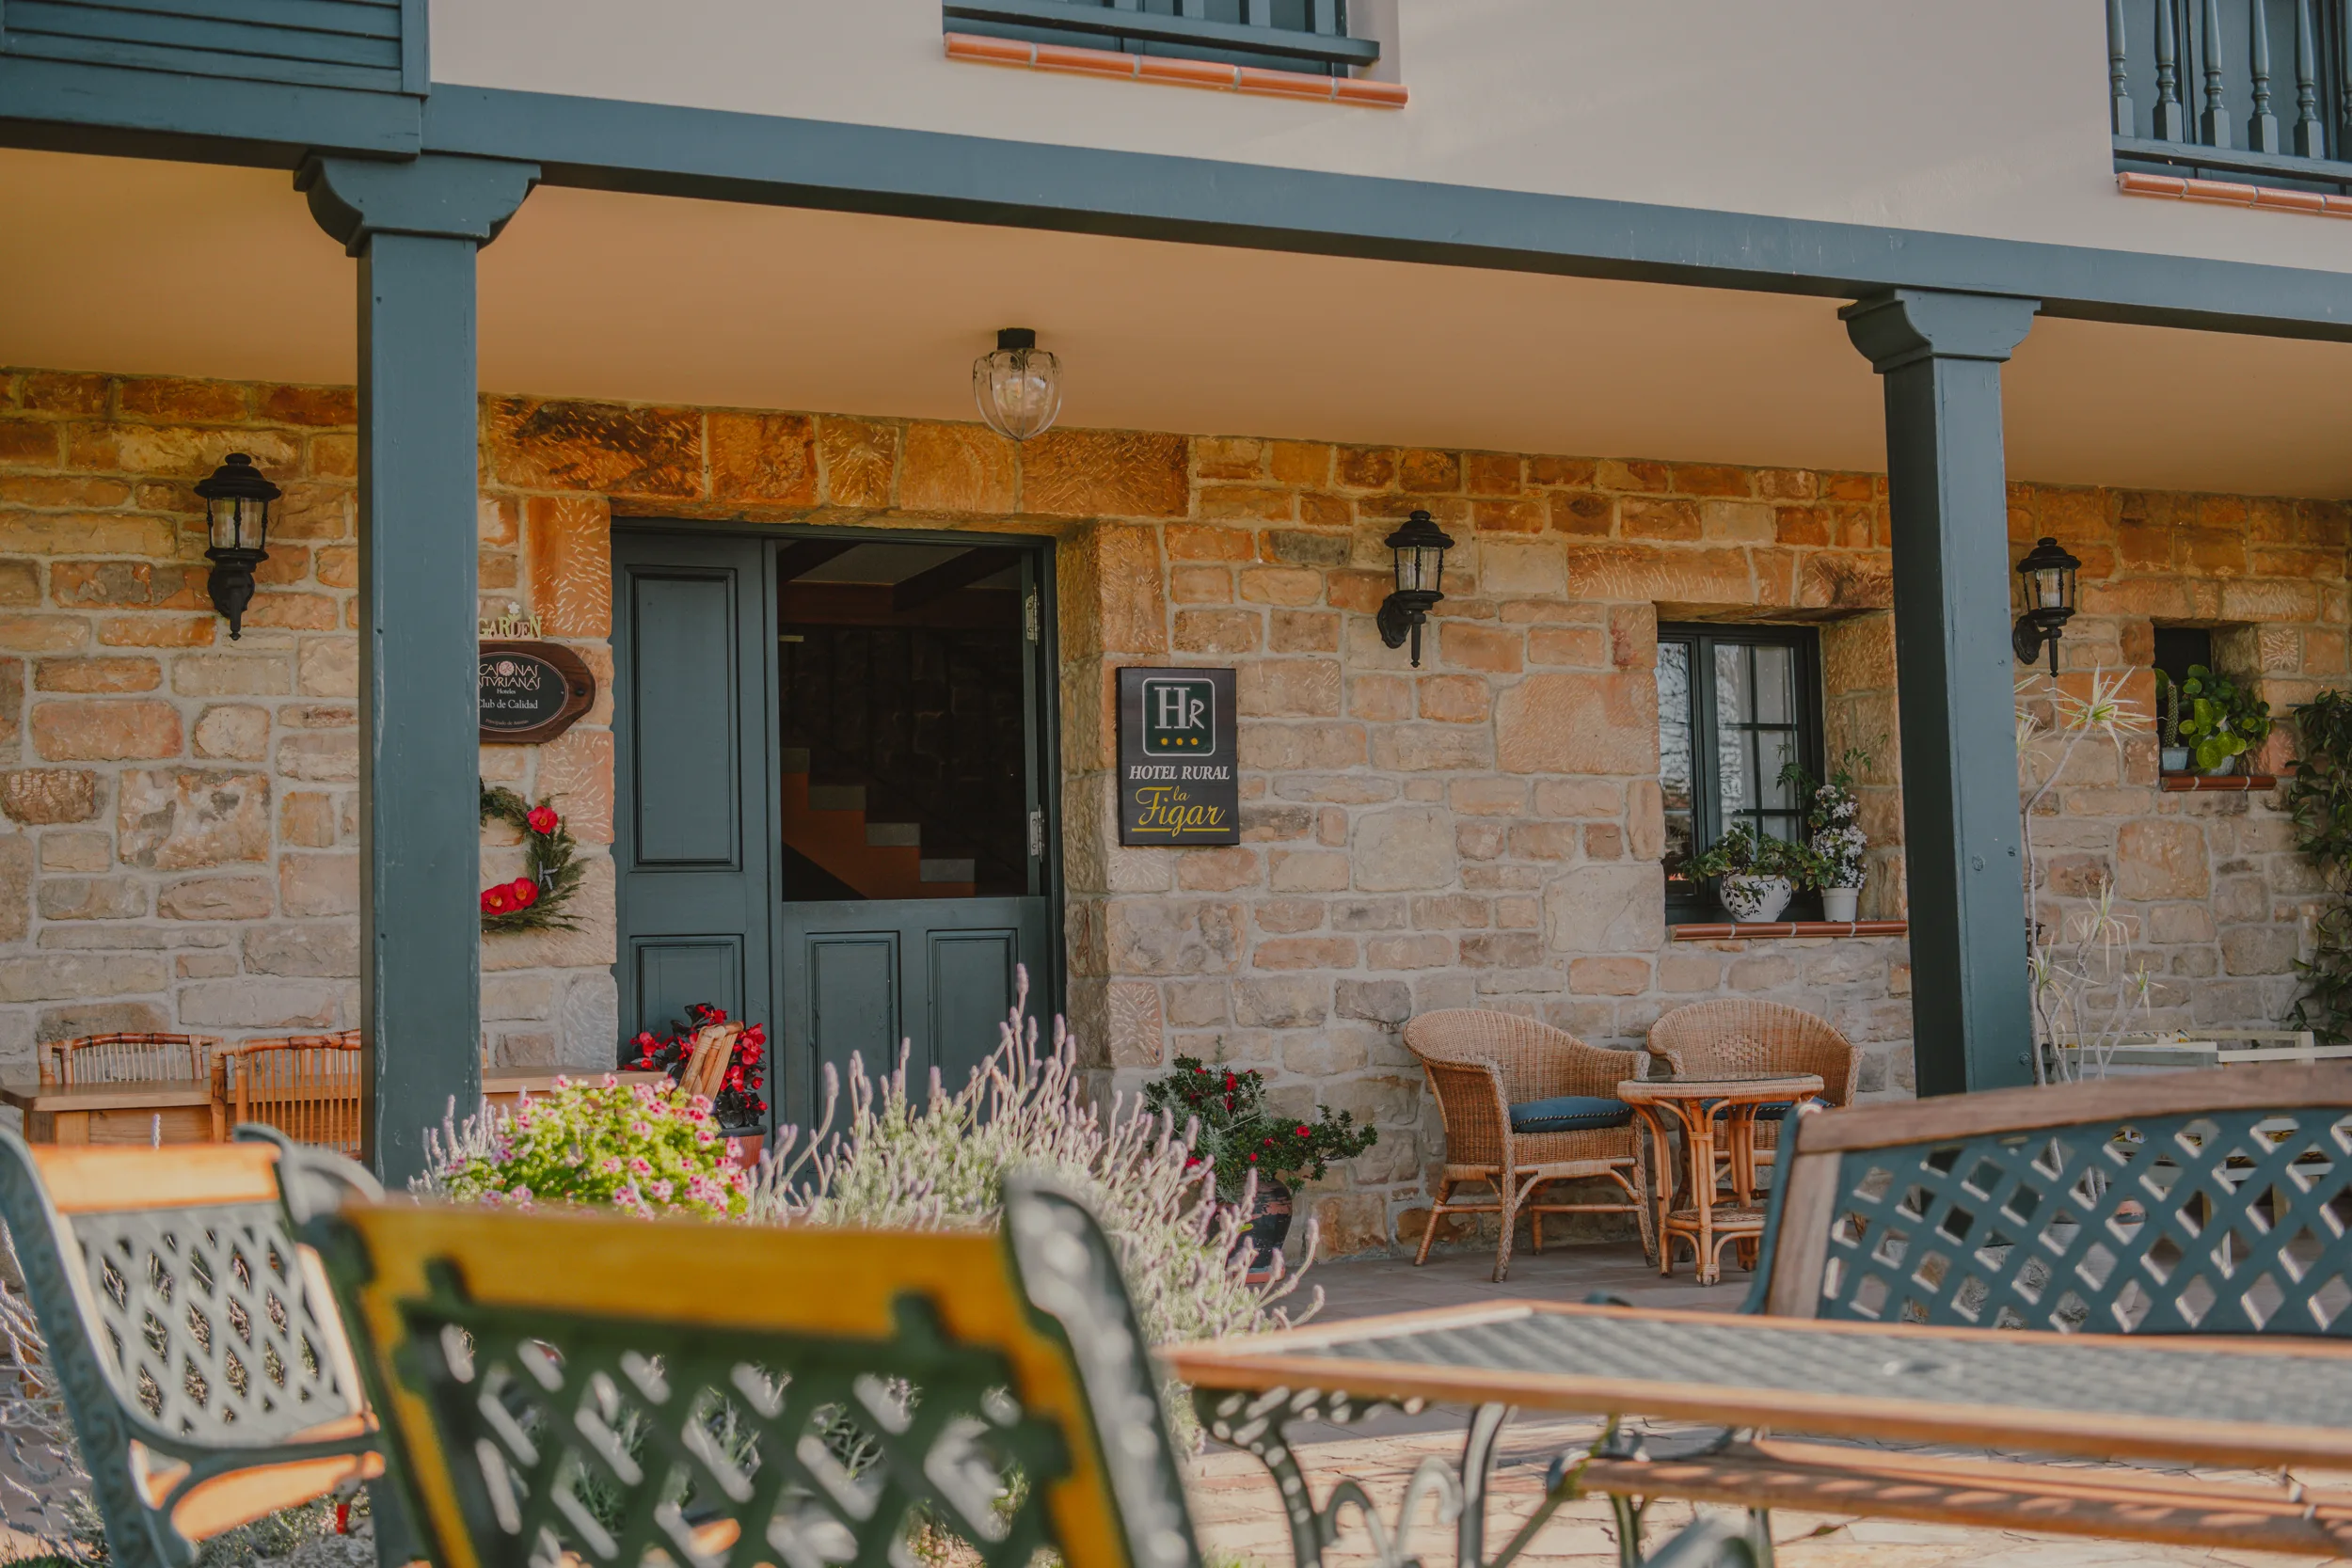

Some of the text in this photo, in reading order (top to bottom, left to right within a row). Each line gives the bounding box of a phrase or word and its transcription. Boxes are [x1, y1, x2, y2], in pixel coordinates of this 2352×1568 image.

[478, 614, 543, 640] GARDEN
[497, 699, 506, 708] de
[507, 699, 538, 709] Calidad
[1129, 766, 1230, 781] HOTEL RURAL
[1136, 785, 1226, 837] la Figar
